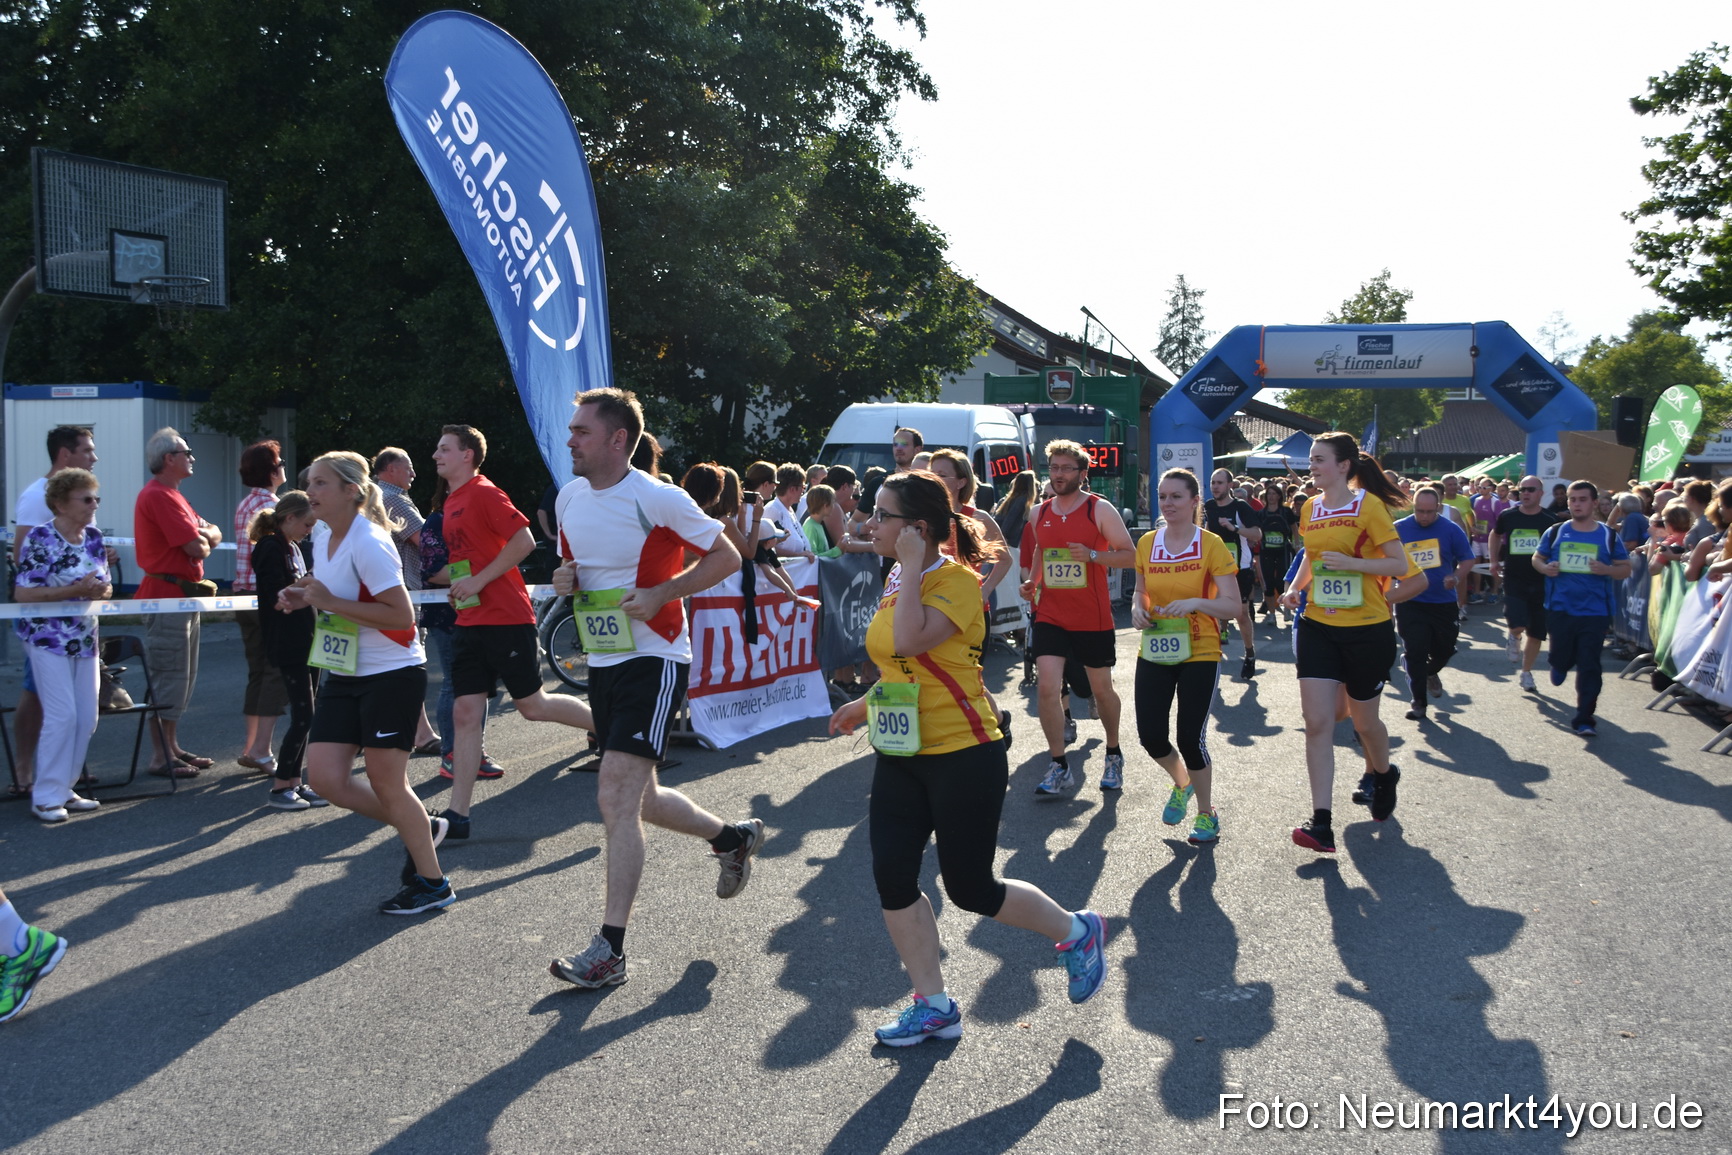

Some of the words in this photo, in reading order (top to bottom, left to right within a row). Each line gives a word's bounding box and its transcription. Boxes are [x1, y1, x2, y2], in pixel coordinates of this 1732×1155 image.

[1344, 354, 1424, 370] firmenlauf
[1198, 383, 1239, 393] Fischer
[1644, 438, 1671, 468] AOK
[1306, 522, 1326, 532] MAX
[1329, 518, 1359, 528] BÖGL
[1513, 538, 1538, 548] 1240
[1412, 551, 1434, 563] 725
[1566, 554, 1588, 566] 771
[1047, 564, 1082, 578] 1373
[1148, 565, 1171, 575] MAX
[1174, 562, 1202, 573] BÖGL
[1322, 579, 1351, 596] 861
[585, 615, 619, 636] 826
[323, 634, 349, 656] 827
[1150, 637, 1180, 653] 889
[877, 711, 910, 736] 909
